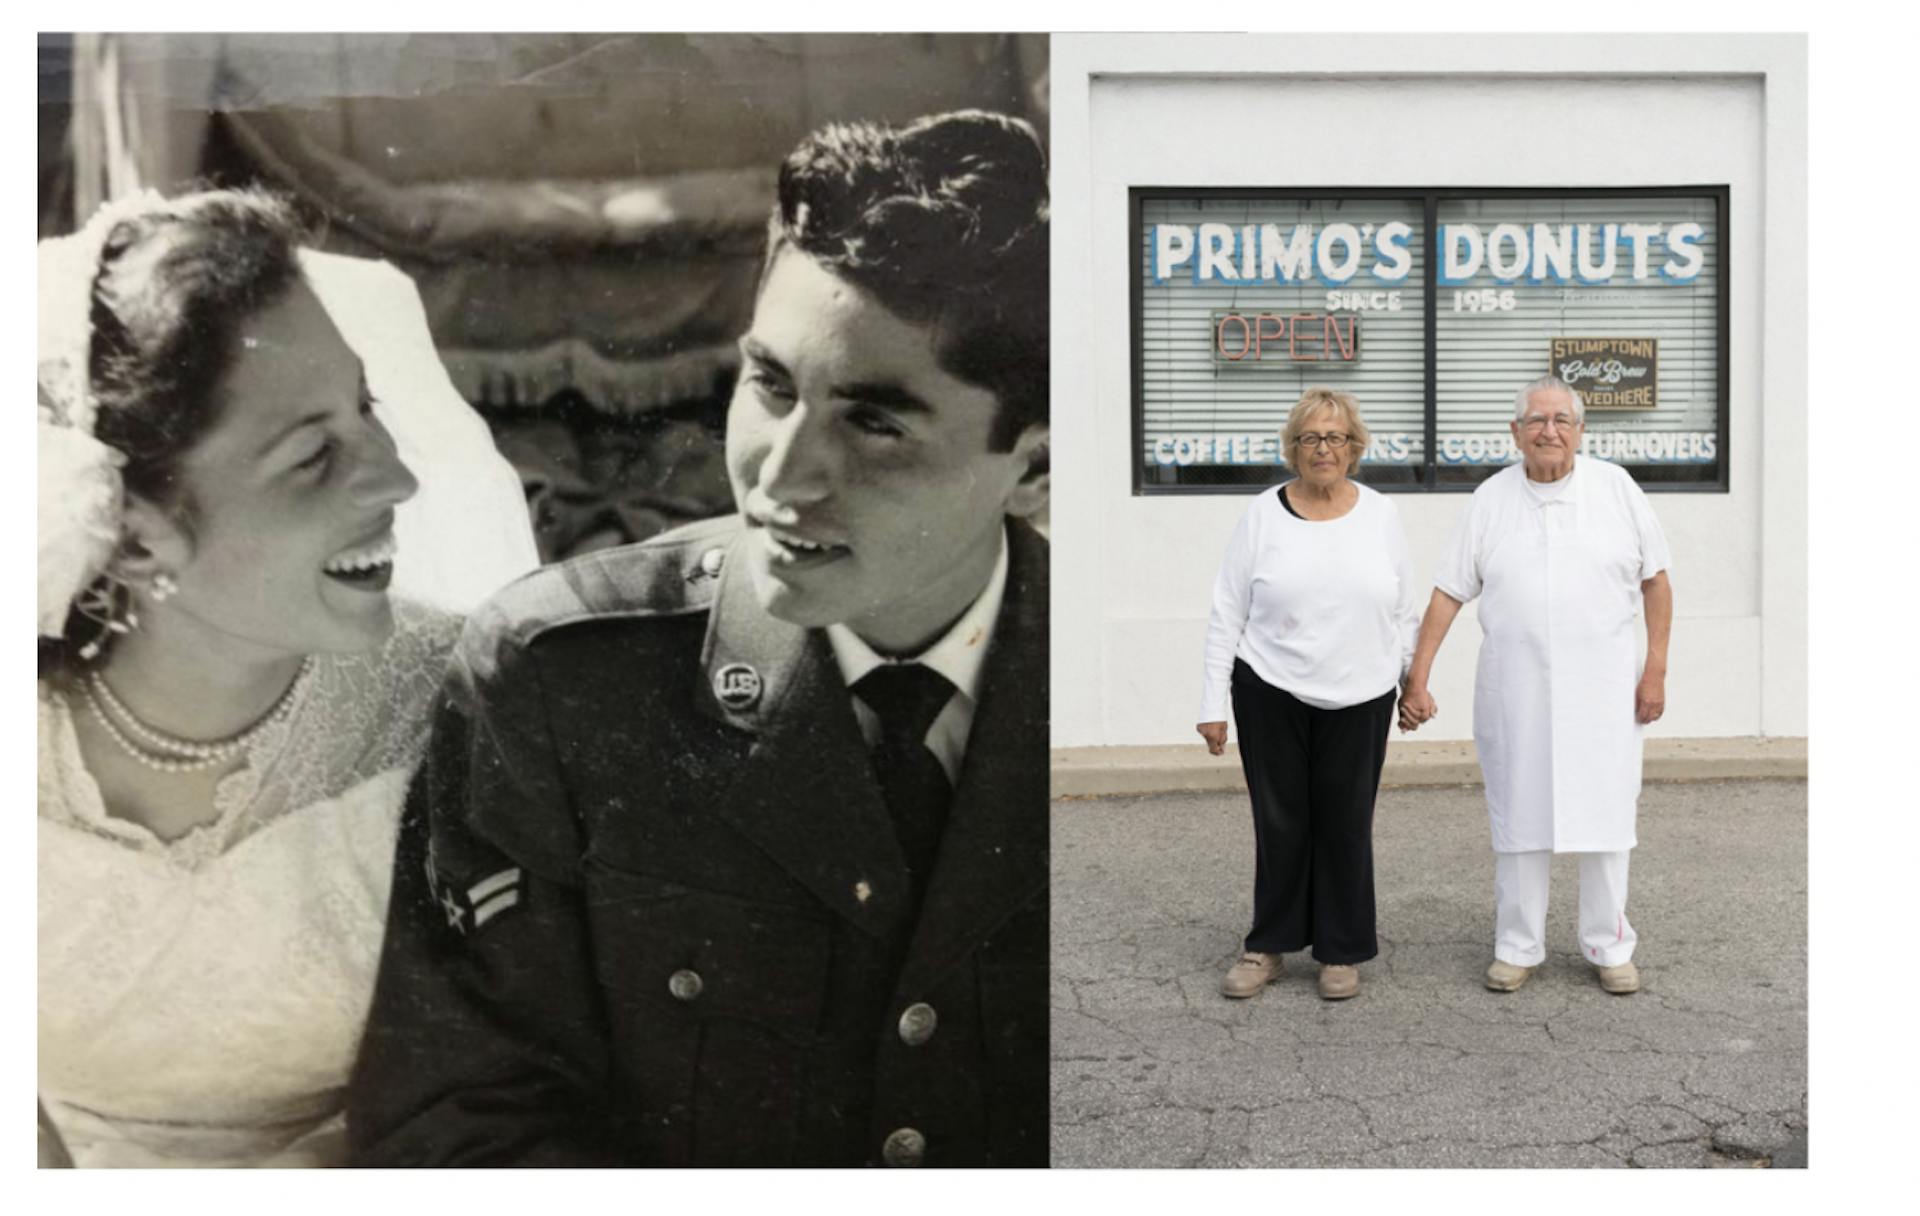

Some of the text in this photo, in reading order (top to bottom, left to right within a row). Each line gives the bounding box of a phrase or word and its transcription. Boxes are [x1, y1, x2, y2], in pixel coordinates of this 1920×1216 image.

[1152, 221, 1704, 286] PRIMO'S DONUTS
[1325, 289, 1517, 313] SINCE 1956
[1217, 313, 1356, 361] OPEN
[1554, 340, 1654, 358] STUMPTOWN
[1559, 359, 1648, 383] Cold Brew
[1614, 386, 1653, 405] HERE
[1153, 433, 1265, 464] COFFEE
